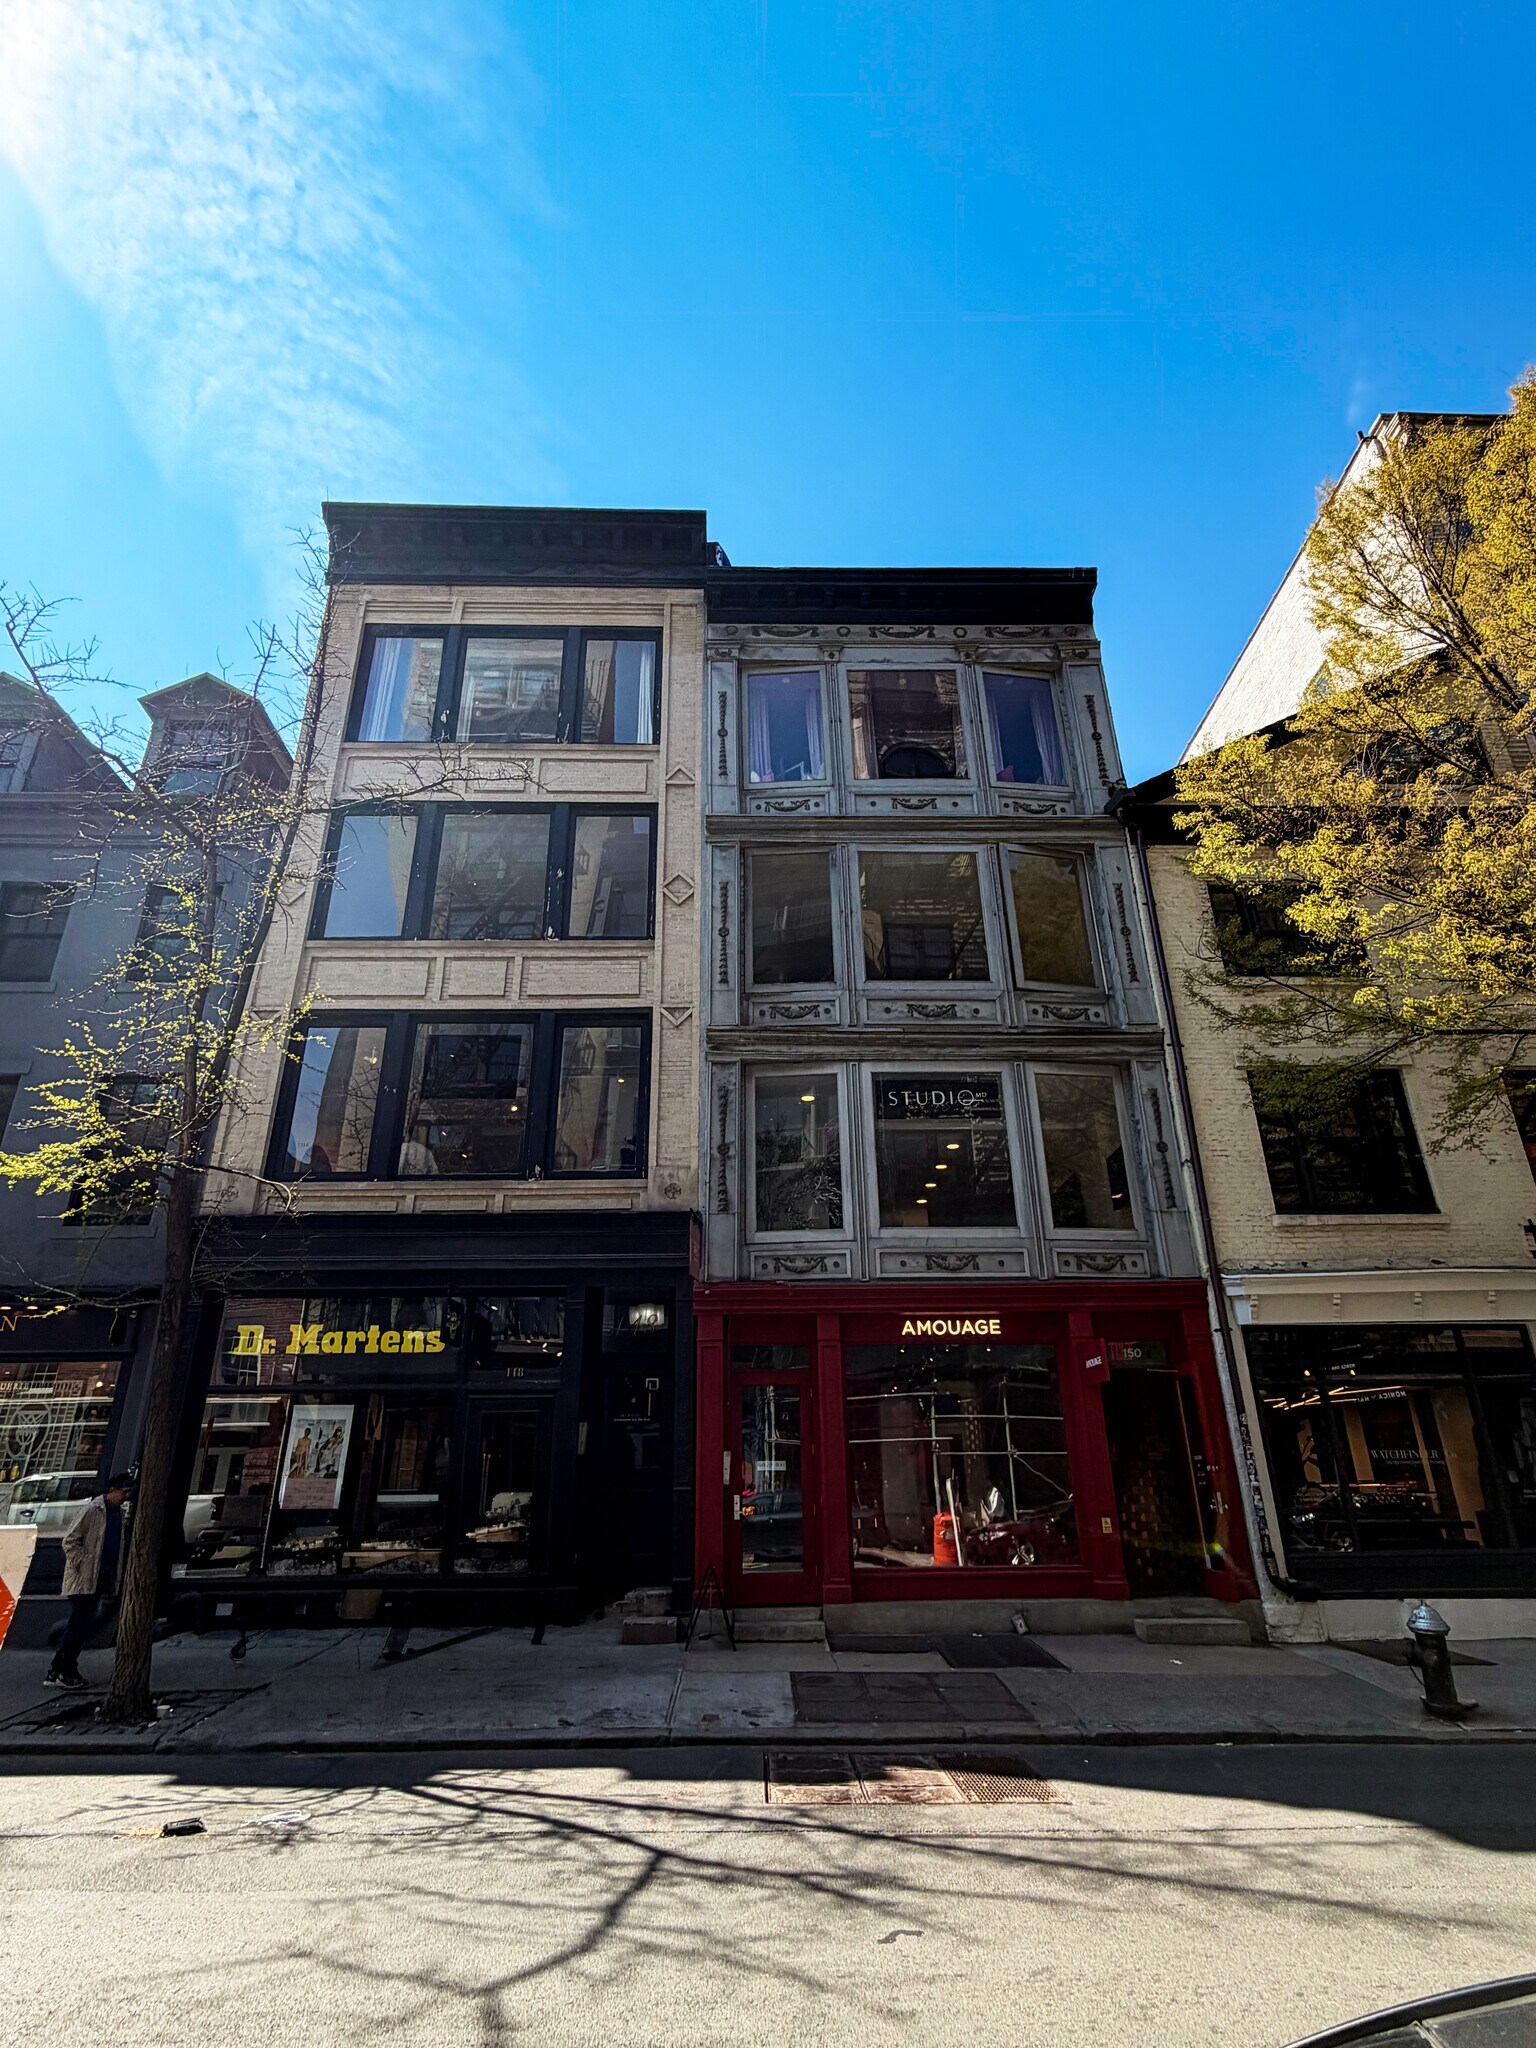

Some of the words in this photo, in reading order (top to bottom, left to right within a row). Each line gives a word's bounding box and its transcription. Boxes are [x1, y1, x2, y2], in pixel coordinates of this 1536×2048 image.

[888, 1090, 978, 1106] STUDIO
[901, 1319, 1002, 1336] AMOUAGE
[230, 1324, 276, 1355] Dr.
[285, 1323, 446, 1355] Martens
[1122, 1348, 1142, 1358] 150
[1370, 1449, 1439, 1459] WATCHFINER
